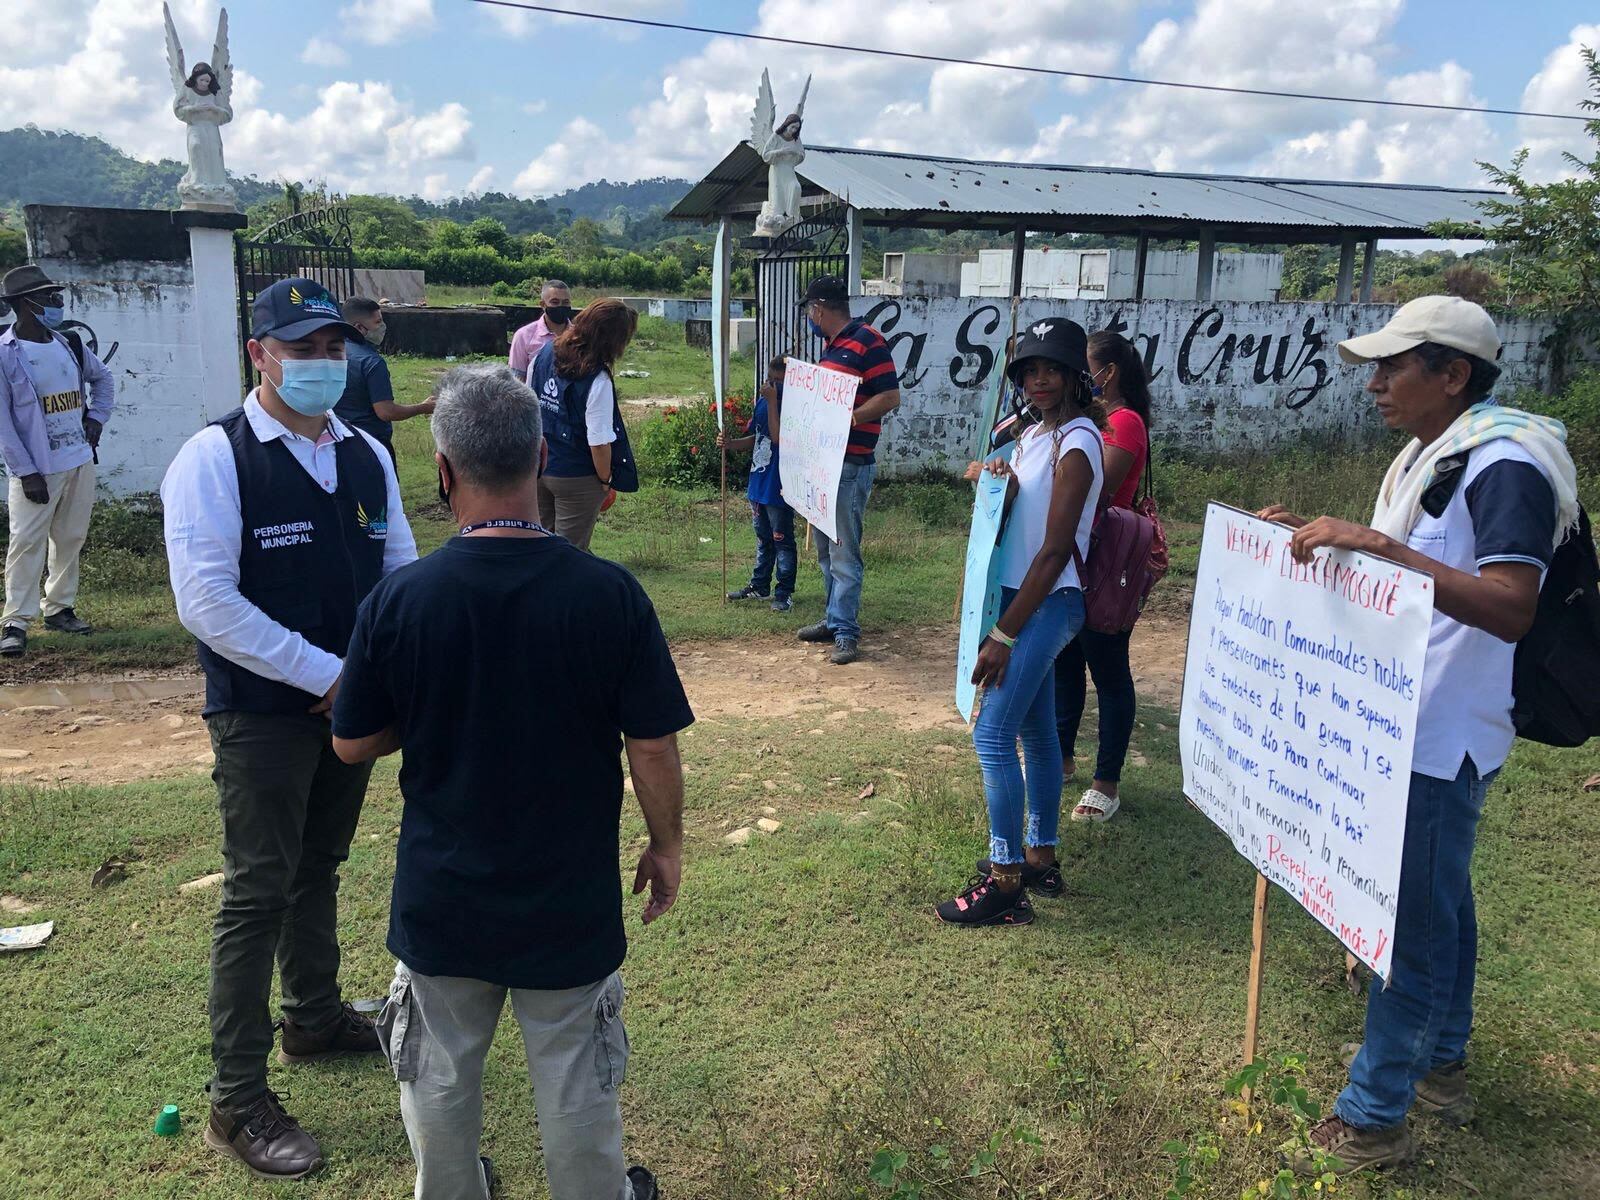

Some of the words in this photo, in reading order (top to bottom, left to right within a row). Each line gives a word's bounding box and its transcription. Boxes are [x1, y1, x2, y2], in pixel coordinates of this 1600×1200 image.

[1177, 308, 1334, 410] Cruz
[253, 520, 315, 539] PERSONERIA
[260, 533, 313, 549] MUNICIPAL
[1218, 630, 1286, 680] perseverantes
[1294, 671, 1321, 698] que
[1331, 682, 1350, 712] han
[1237, 594, 1277, 642] habitan
[1284, 619, 1368, 675] Comunidades
[1373, 656, 1414, 701] nobles
[1221, 672, 1262, 708] embates
[1269, 688, 1284, 721] de
[1294, 700, 1306, 731] la
[1318, 722, 1352, 757] guerra
[1362, 745, 1369, 771] y
[1284, 740, 1308, 769] Para
[1193, 740, 1224, 782] Unidos
[1242, 785, 1251, 810] la
[1321, 832, 1332, 867] la
[1227, 745, 1259, 778] acciones
[1267, 769, 1322, 816] Fomentan
[1331, 801, 1340, 828] la
[1237, 810, 1246, 838] la
